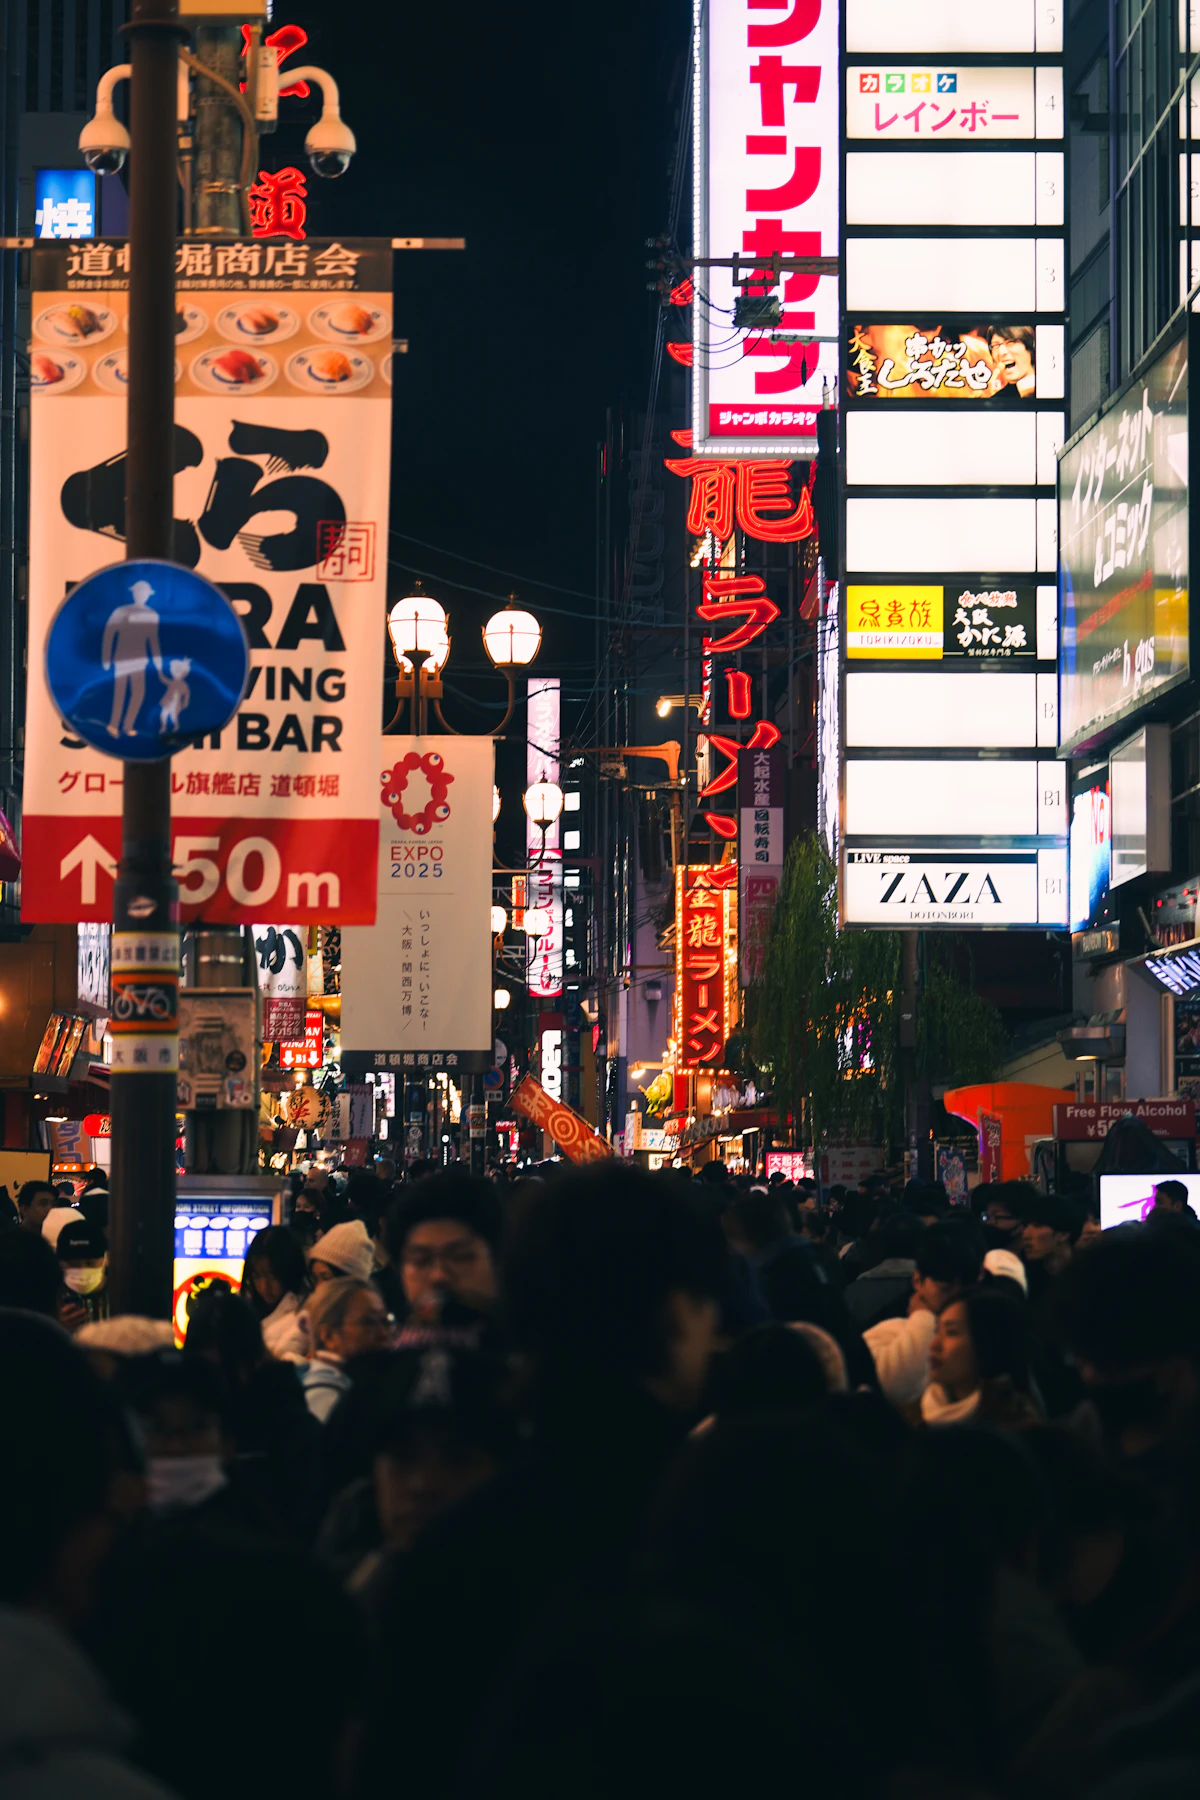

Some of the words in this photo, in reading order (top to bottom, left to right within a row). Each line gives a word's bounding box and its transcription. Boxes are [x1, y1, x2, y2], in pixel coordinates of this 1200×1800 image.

[860, 73, 957, 93] カラオケ
[875, 100, 1020, 133] レインボー
[66, 243, 361, 277] 道堀商店会
[905, 332, 968, 360] 串かつ
[719, 411, 817, 426] ジャンボカラオケ
[952, 608, 994, 626] 大阪
[860, 635, 933, 645] TORIKIZOKU
[957, 624, 1027, 648] かに源
[236, 713, 344, 753] BAR
[270, 774, 341, 798] 道頓堀
[753, 752, 771, 807] 大起水産
[753, 808, 771, 863] 回転寿司
[391, 846, 443, 861] EXPO
[854, 853, 881, 864] LIVE
[391, 863, 443, 878] 2025
[880, 872, 1003, 904] ZAZA
[909, 911, 975, 919] DOTONBORI
[685, 875, 722, 1066] 金龍ラーメン
[374, 1053, 459, 1066] 道頓堀商店会
[1066, 1106, 1096, 1117] Free
[1135, 1104, 1187, 1117] Alcohol
